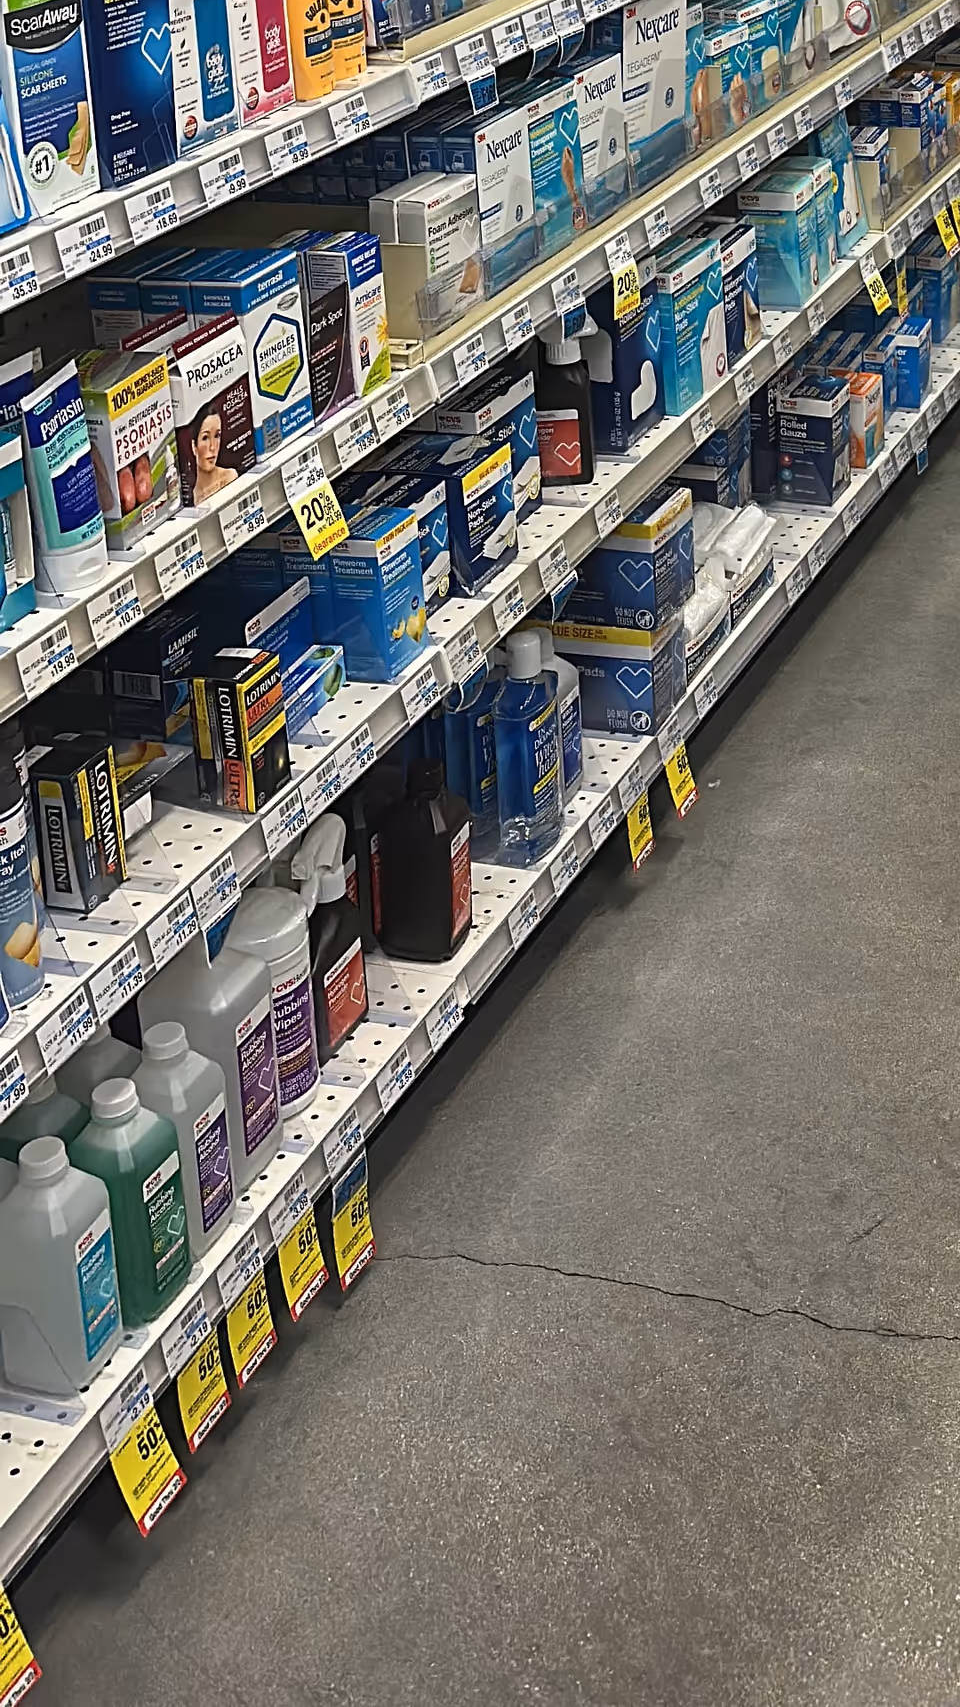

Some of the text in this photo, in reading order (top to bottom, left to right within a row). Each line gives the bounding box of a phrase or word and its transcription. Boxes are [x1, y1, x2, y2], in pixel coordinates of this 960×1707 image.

[10, 2, 80, 37] ScarAway
[635, 7, 681, 45] Nexcare
[20, 67, 55, 87] SILICONE
[21, 75, 68, 99] SCAR SHEETS
[583, 72, 617, 104] Nexcare
[486, 128, 523, 164] Nexcare
[34, 158, 50, 176] #1
[428, 206, 474, 238] Foam Adhesive
[257, 270, 284, 293] terrasil
[310, 307, 343, 336] Dark Spot
[259, 333, 296, 361] SHINGLES
[260, 344, 296, 372] SKINCARE
[186, 345, 243, 388] PROSACEA
[40, 397, 84, 442] Psoriasin
[115, 405, 172, 454] PSORIASIS
[780, 420, 807, 431] Rolled
[117, 427, 164, 465] FORMULA
[780, 429, 807, 440] Gauze
[301, 500, 323, 528] 20
[466, 495, 498, 522] Non-Stick
[313, 525, 347, 554] clearance
[334, 566, 374, 576] Treatment
[381, 557, 412, 585] Treatment
[167, 626, 198, 655] LAMISIL
[572, 627, 595, 640] SIZE
[246, 668, 282, 706] LOTRIMIN
[217, 686, 238, 758] LOTRIMIN
[225, 760, 241, 810] ULTRA
[94, 759, 117, 868] LOTRIMIN
